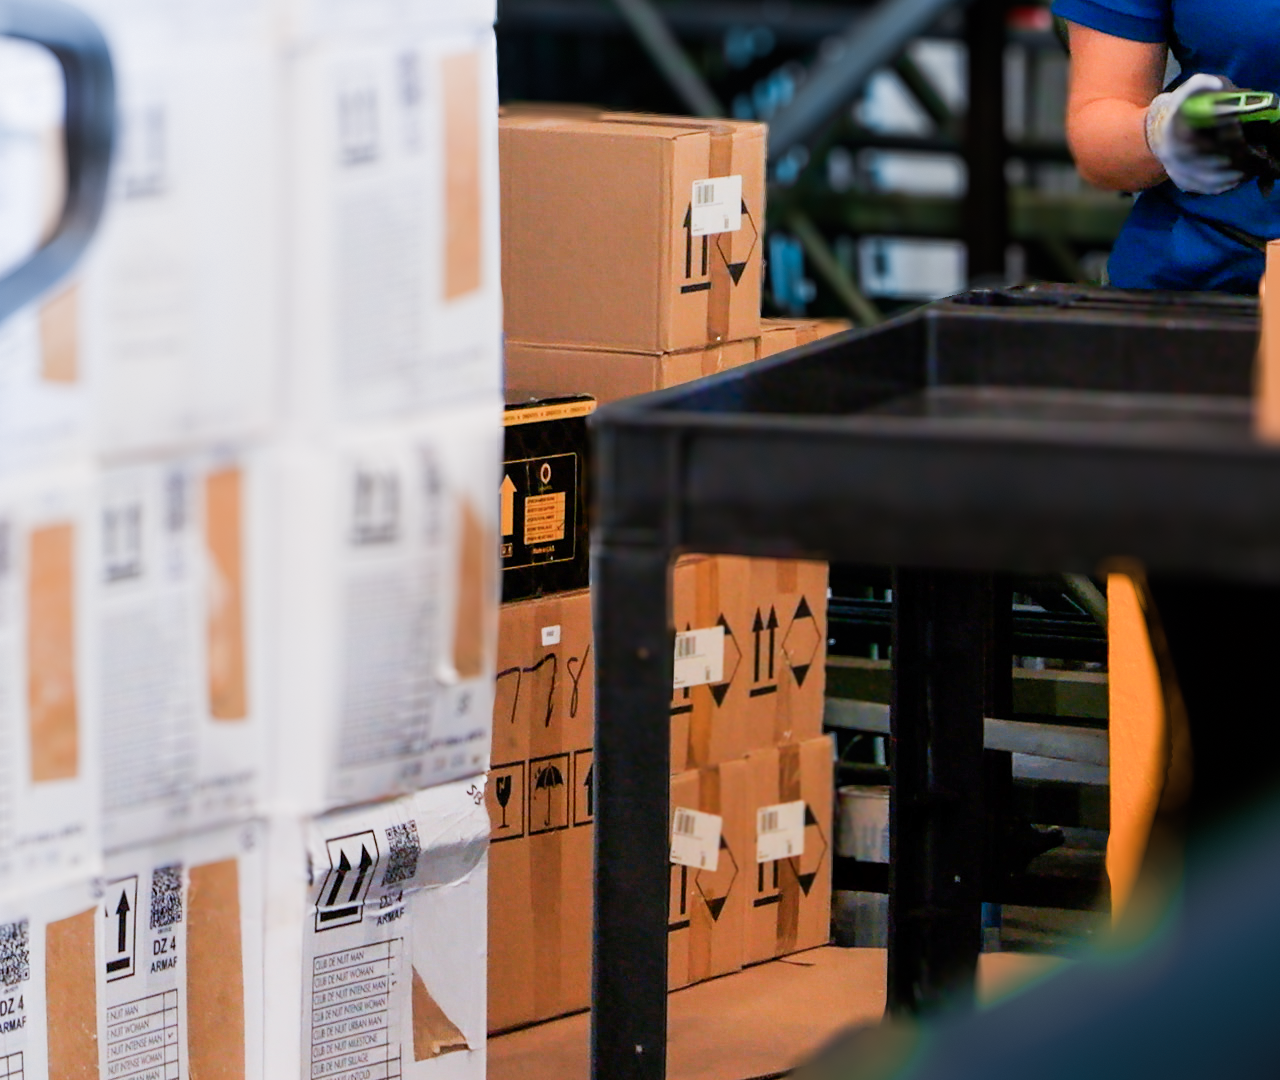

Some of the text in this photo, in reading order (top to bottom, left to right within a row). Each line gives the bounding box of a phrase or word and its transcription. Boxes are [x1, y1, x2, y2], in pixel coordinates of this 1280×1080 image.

[153, 935, 176, 955] DZ 4
[150, 956, 178, 974] ARMAF
[0, 994, 24, 1017] DZ 4
